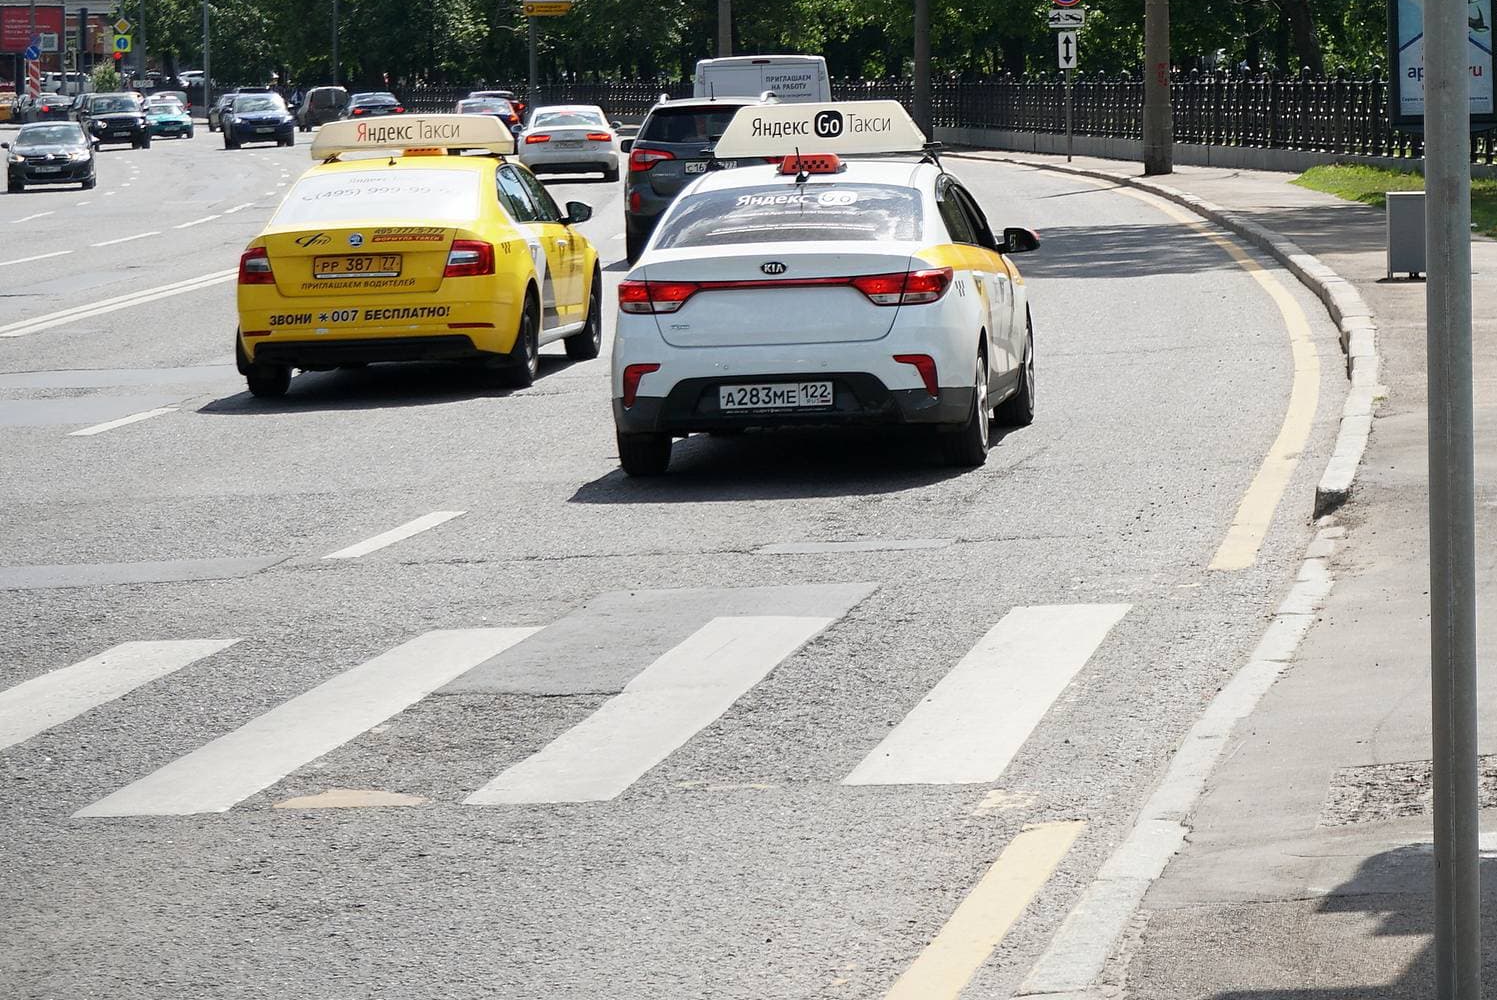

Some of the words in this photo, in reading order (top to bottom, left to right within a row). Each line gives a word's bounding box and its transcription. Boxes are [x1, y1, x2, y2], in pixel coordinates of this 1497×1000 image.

[766, 75, 811, 83] ПРИГЛАШАЕМ
[357, 122, 413, 143] Яндекс
[416, 119, 460, 139] Такси
[752, 117, 809, 137] Яндекс
[818, 114, 840, 134] Go
[847, 113, 891, 132] Такси
[735, 194, 811, 206] Яндекс
[345, 258, 374, 271] 387
[381, 256, 397, 268] 77
[763, 263, 784, 273] KIA
[302, 281, 362, 290] ПРИГЛАШАЕМ
[364, 278, 416, 288] ВОДИТЕЛЕЙ
[269, 313, 312, 326] ЗВОНИ
[364, 306, 451, 321] БЕСПЛАТНО!
[725, 386, 797, 407] А283МЕ
[801, 383, 829, 399] 122
